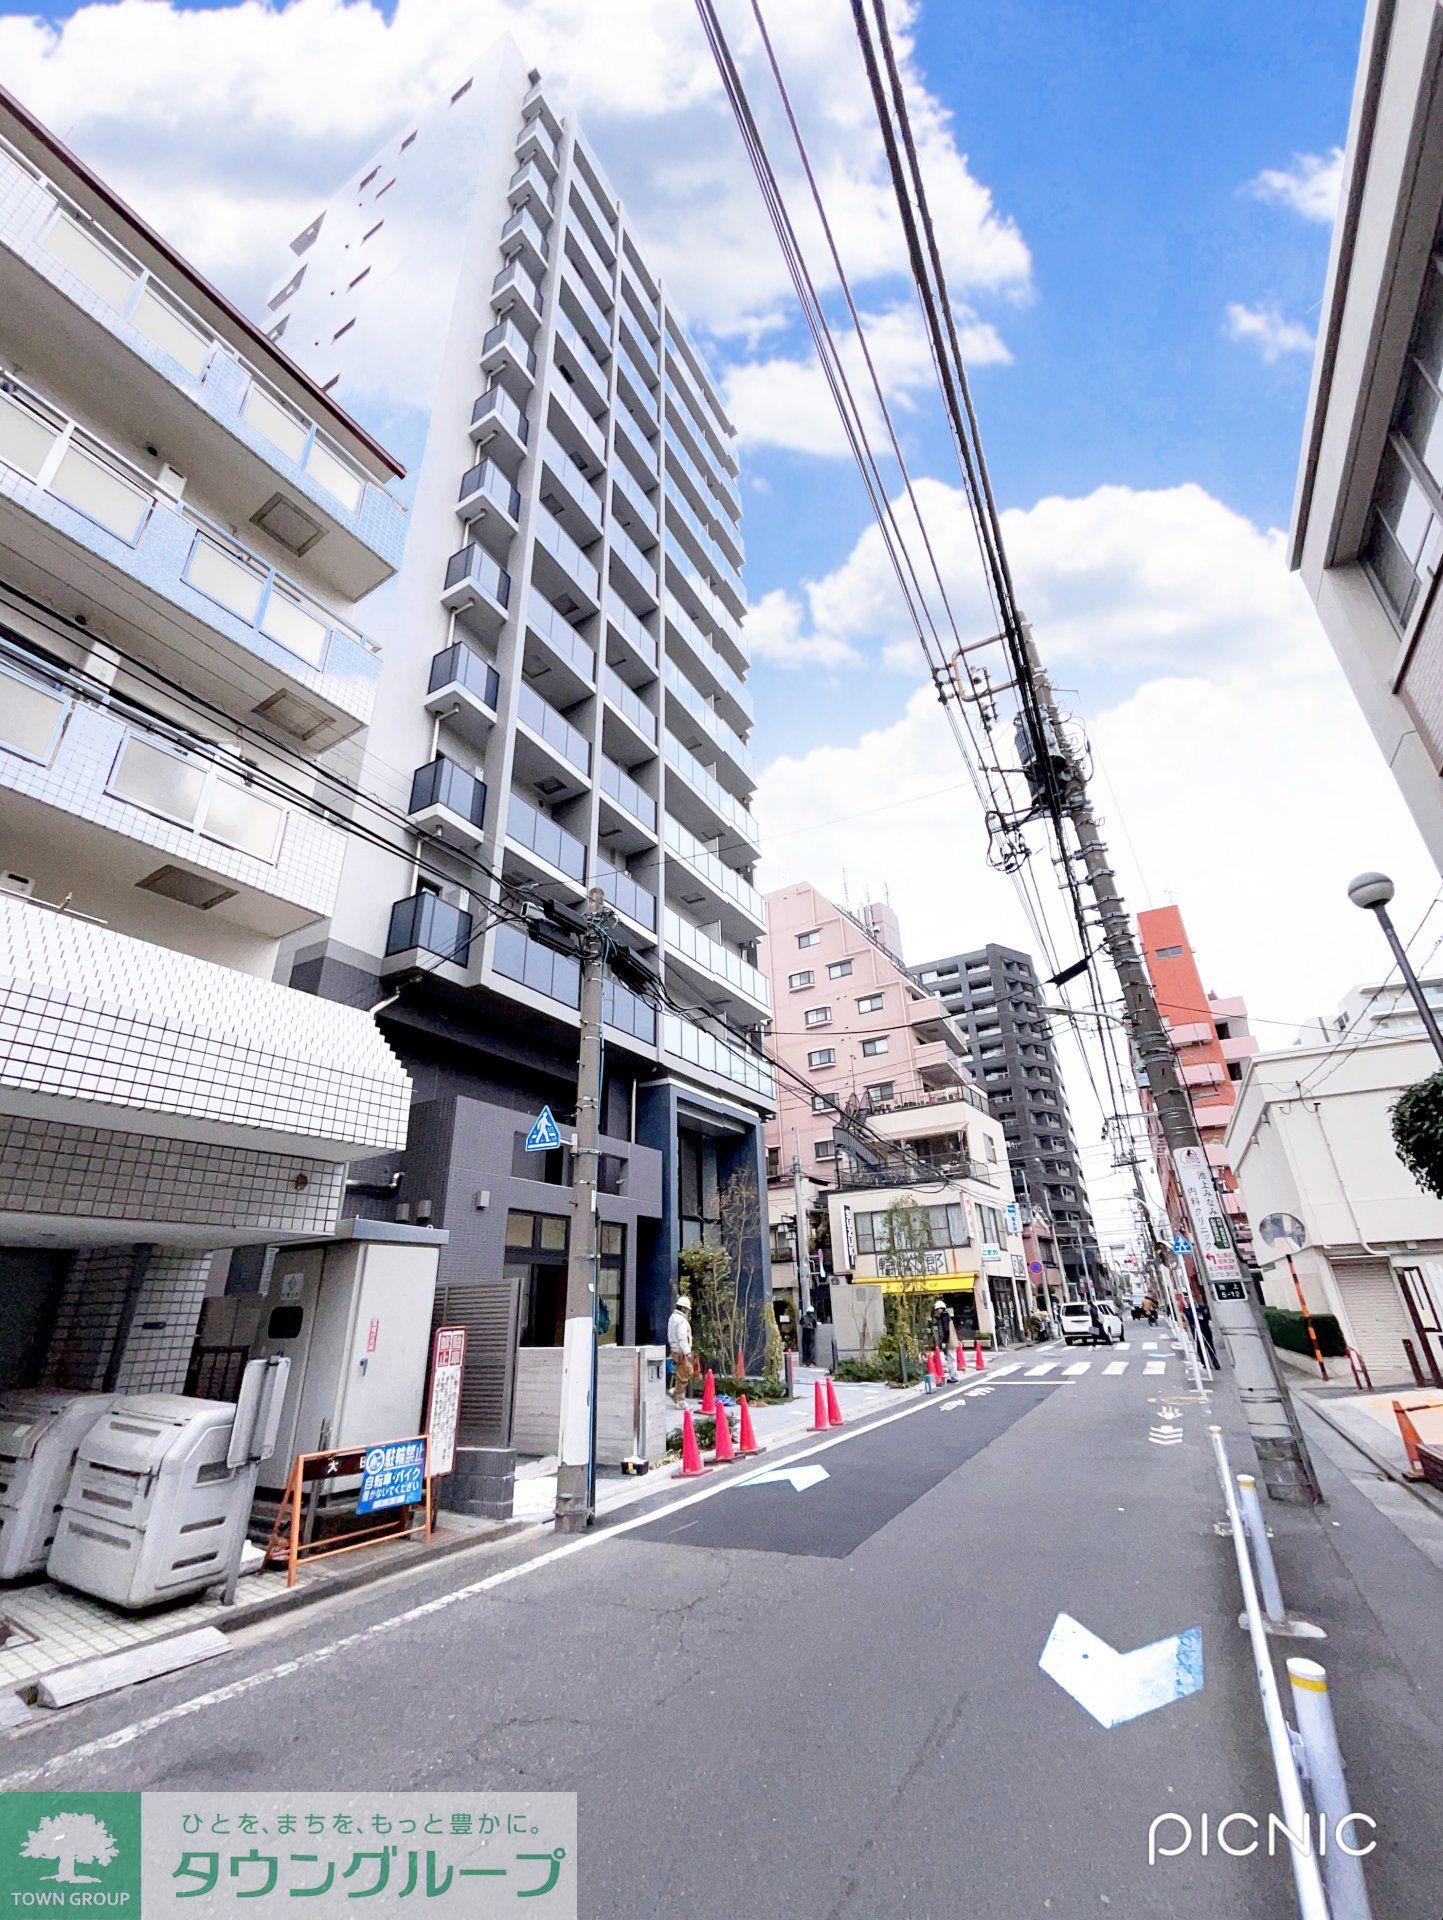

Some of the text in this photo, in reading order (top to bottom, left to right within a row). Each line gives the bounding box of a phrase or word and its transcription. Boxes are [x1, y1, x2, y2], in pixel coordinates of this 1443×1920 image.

[1197, 1170, 1217, 1215] 池上みなみ
[1188, 1187, 1212, 1250] 内科クリニック
[845, 1209, 855, 1266] SUZUKI
[1221, 1290, 1240, 1298] 5-12
[384, 1442, 424, 1468] 駐輪禁止
[364, 1467, 421, 1490] 自転車・バイク
